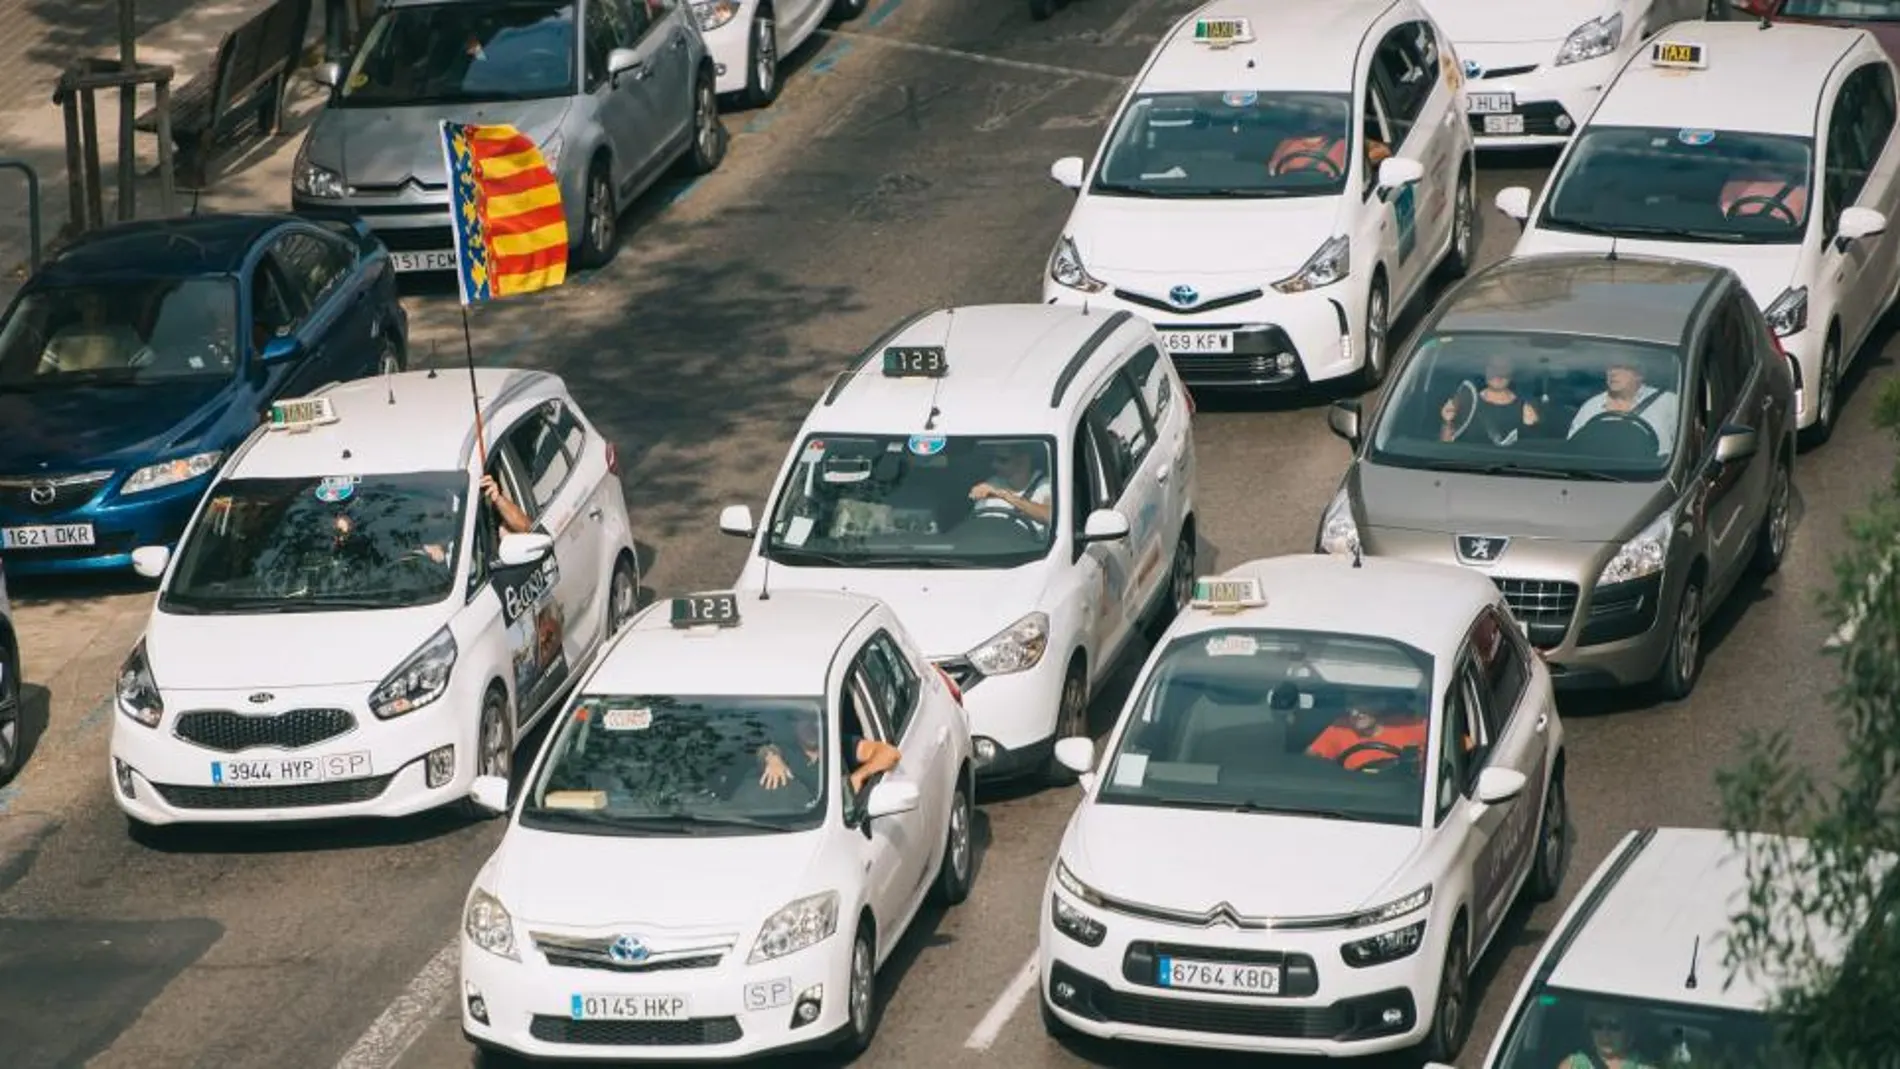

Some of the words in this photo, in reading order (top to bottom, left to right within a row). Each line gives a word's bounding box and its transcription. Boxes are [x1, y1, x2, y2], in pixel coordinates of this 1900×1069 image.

[1209, 20, 1234, 37] TAXI
[1662, 45, 1691, 61] TAXI
[1476, 96, 1509, 111] HLH
[9, 528, 48, 546] 1621
[55, 525, 89, 544] DKR
[1210, 582, 1238, 601] TAXI
[228, 762, 272, 781] 3944
[281, 760, 313, 778] HYP
[1173, 963, 1225, 986] 6764
[1233, 968, 1274, 989] KBD
[585, 997, 639, 1016] 0145
[644, 998, 684, 1017] HKP
